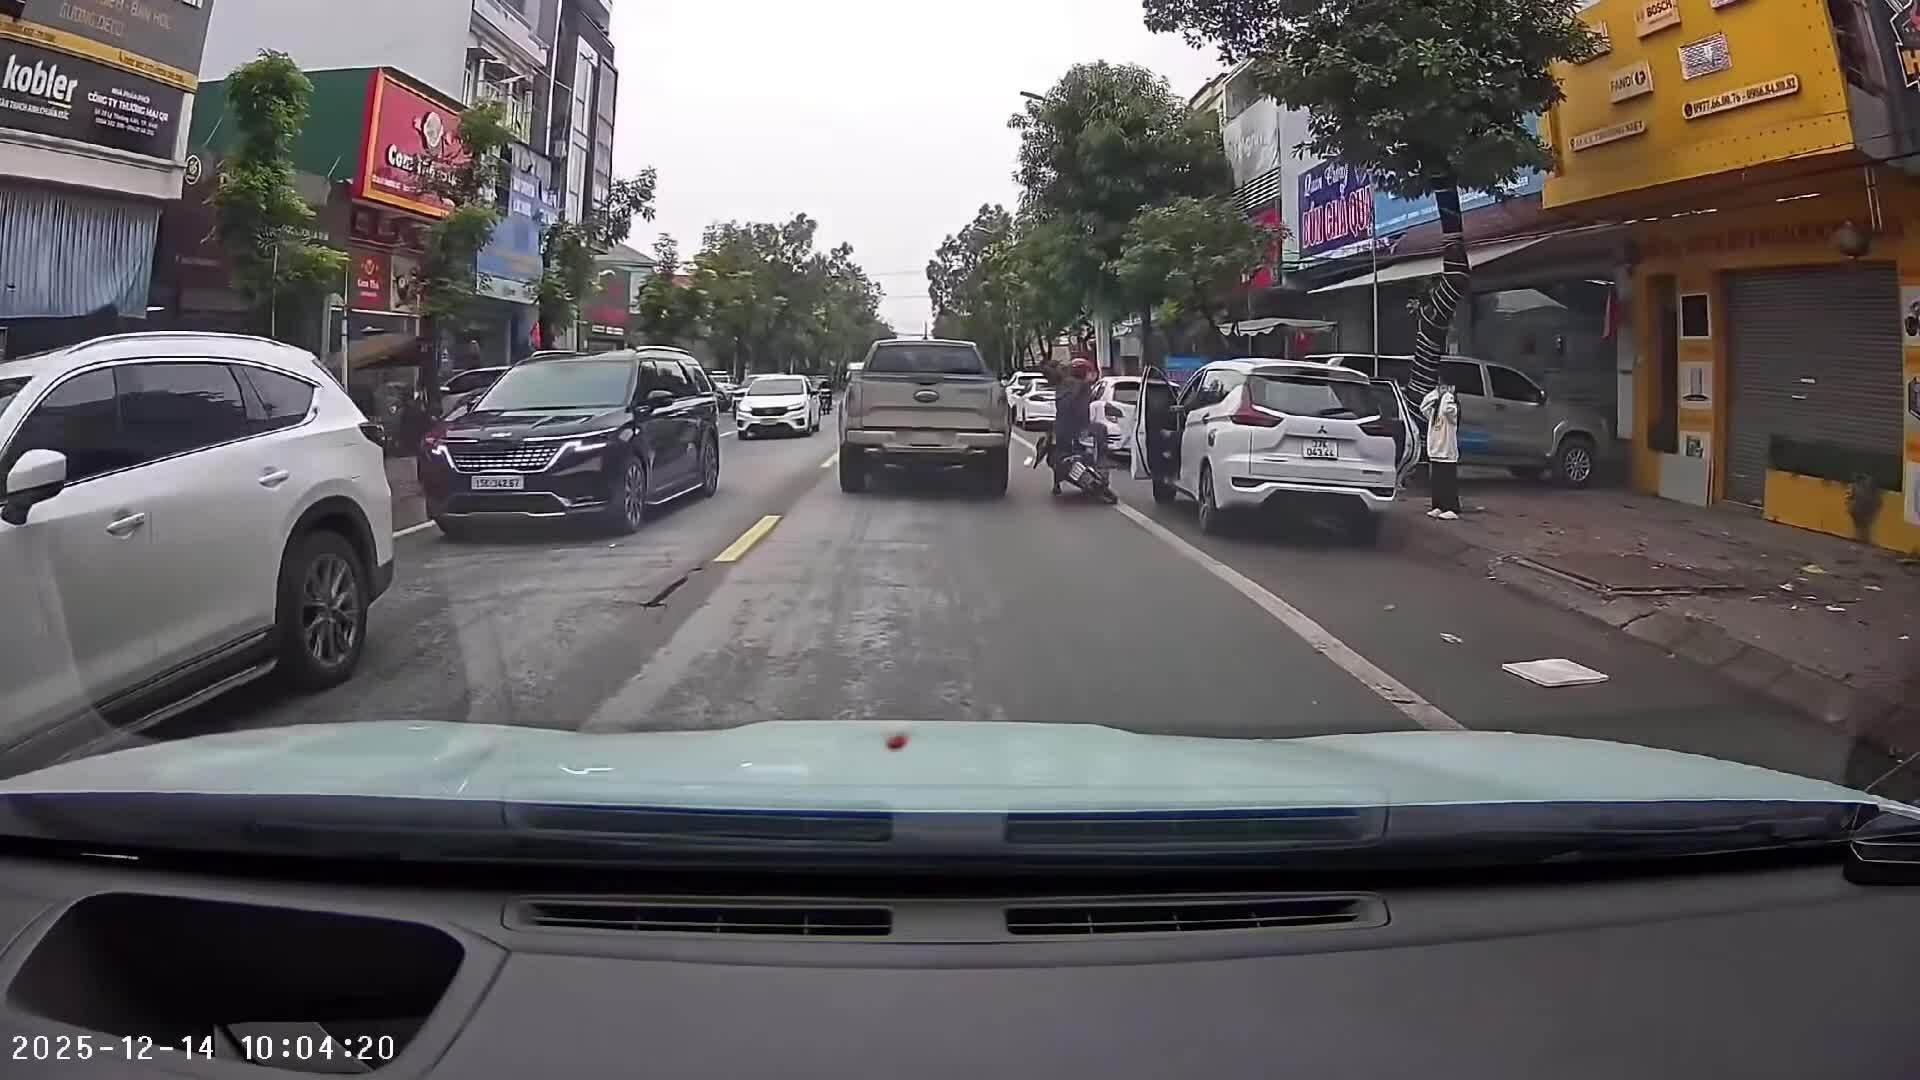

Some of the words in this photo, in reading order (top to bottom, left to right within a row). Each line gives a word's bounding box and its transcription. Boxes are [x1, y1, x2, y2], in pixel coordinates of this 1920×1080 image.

[1646, 0, 1672, 17] BOSCH
[2, 54, 78, 102] kobler
[1610, 73, 1634, 92] FANDI
[108, 97, 118, 108] TY
